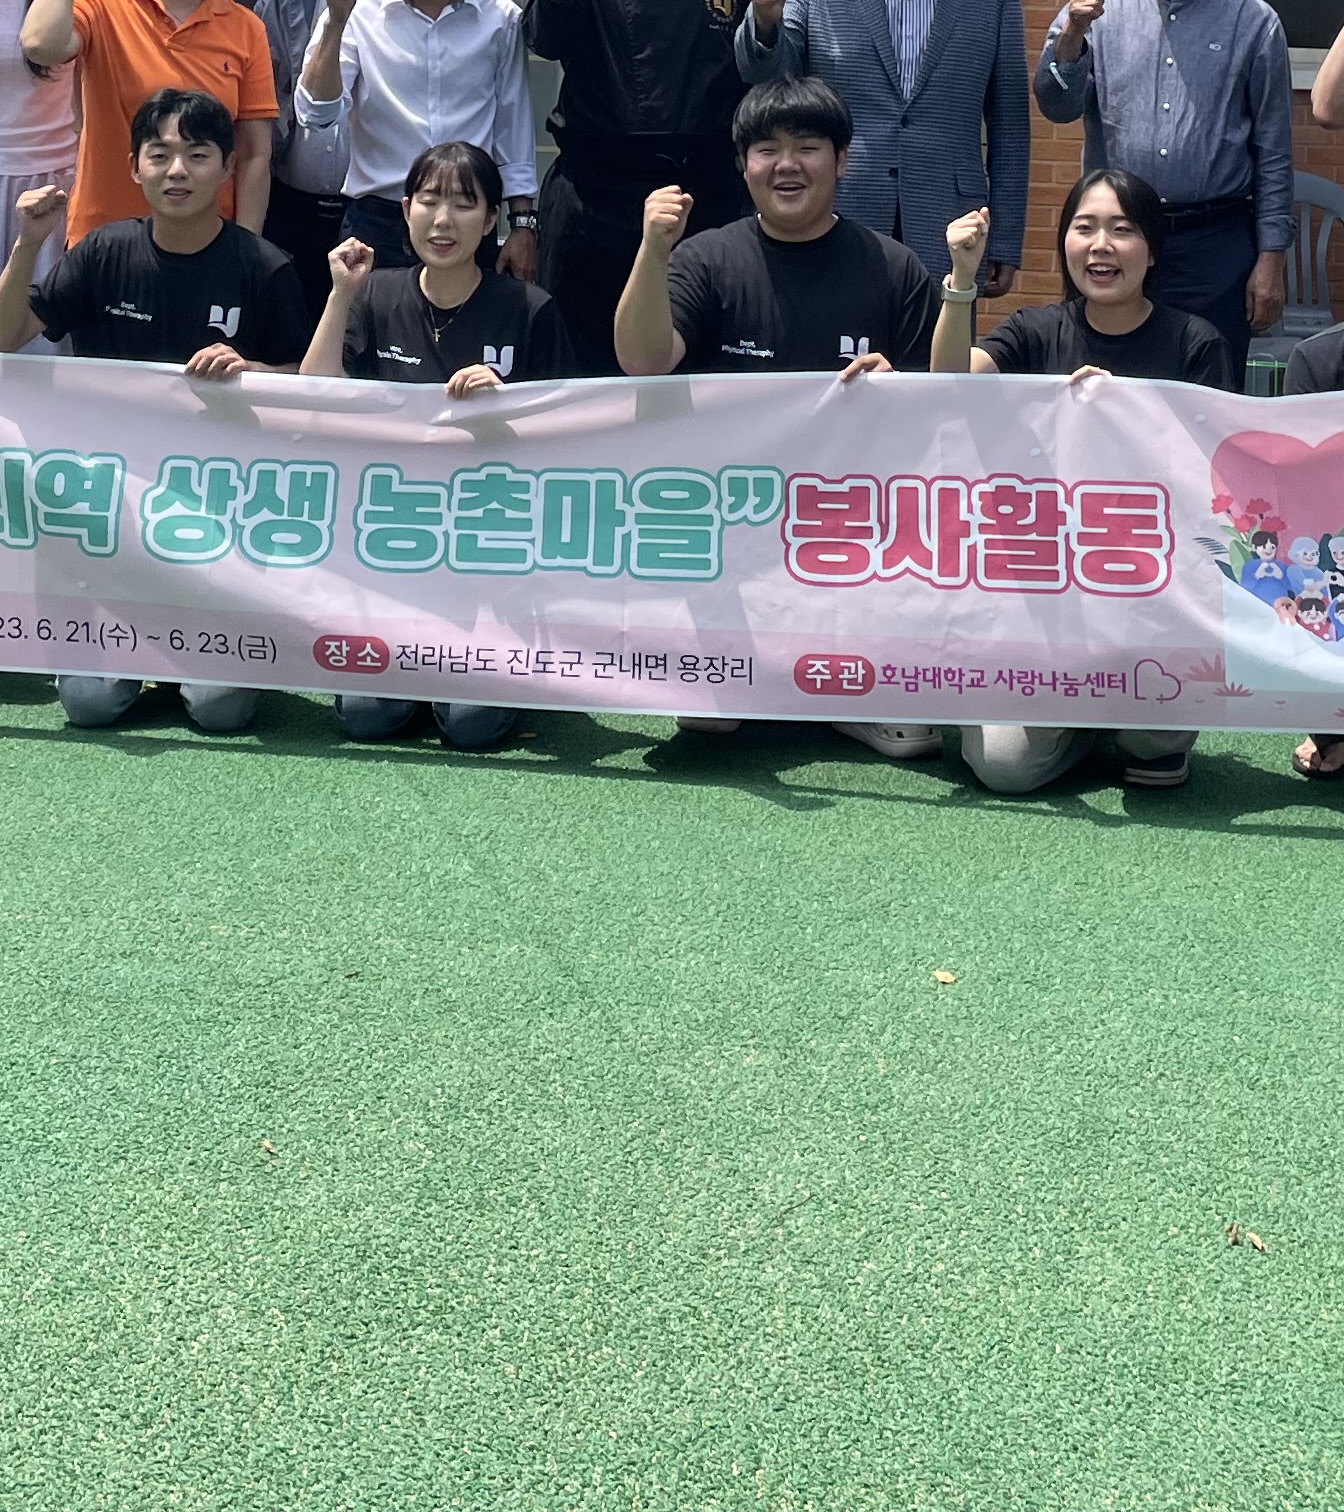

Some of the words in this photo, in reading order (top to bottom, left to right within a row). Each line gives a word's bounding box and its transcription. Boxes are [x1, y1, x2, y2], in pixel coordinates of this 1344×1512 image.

[141, 454, 339, 569] 상생
[66, 619, 138, 652] 21.(수)
[198, 632, 278, 664] 23.(금)
[395, 642, 498, 675] 전라남도
[506, 648, 584, 679] 진도군
[591, 651, 668, 682] 군내면
[676, 653, 754, 686] 용장리
[878, 663, 988, 694] 호남대학교
[994, 667, 1127, 698] 사랑나눔센터
